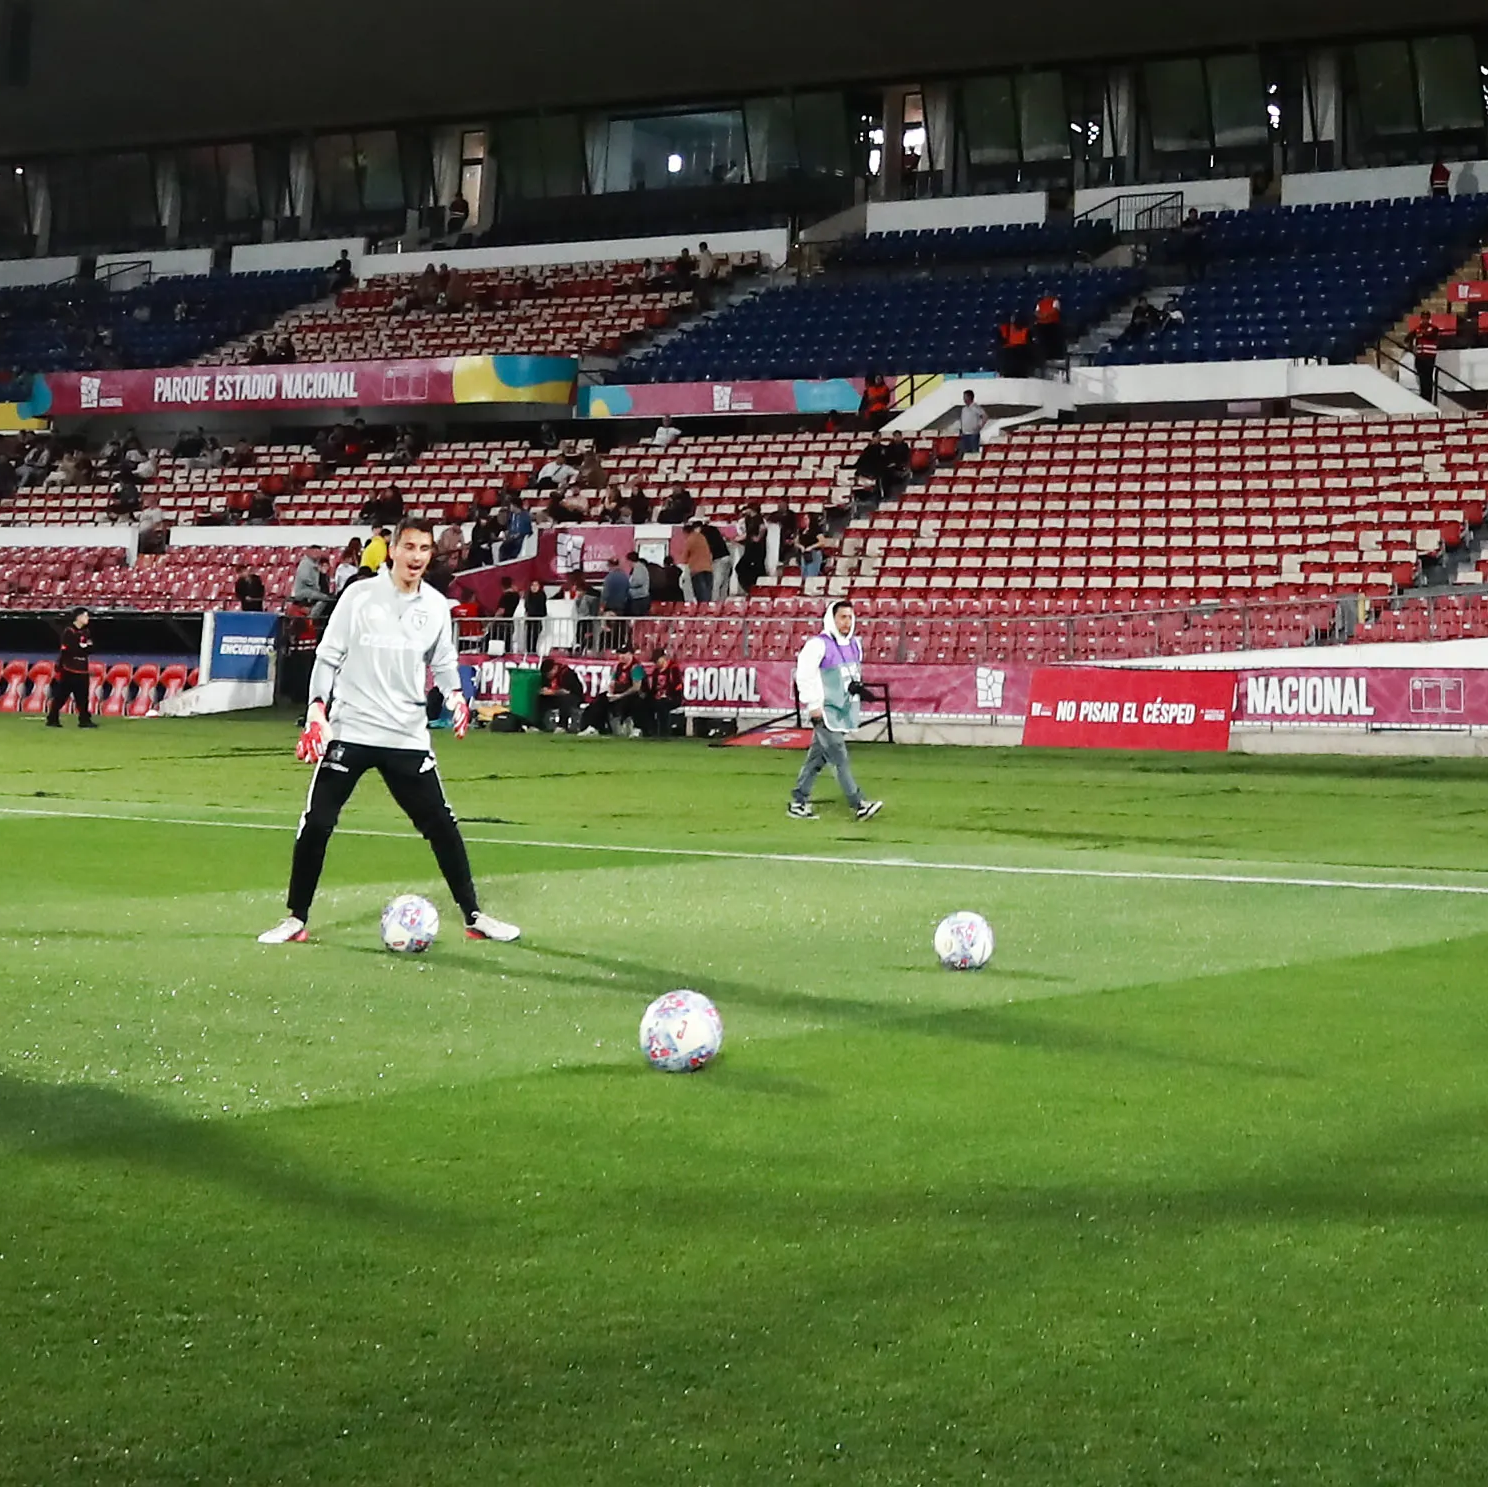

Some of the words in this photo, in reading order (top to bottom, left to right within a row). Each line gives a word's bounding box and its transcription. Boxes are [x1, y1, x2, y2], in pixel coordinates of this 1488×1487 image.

[153, 375, 210, 405] PARQUE
[214, 373, 277, 401] ESTADIO
[281, 371, 359, 400] NACIONAL
[683, 665, 762, 702] CIONAL
[1247, 676, 1375, 716] NACIONAL
[1055, 700, 1077, 722] NO
[1078, 700, 1120, 724] PISAR
[1122, 702, 1139, 724] EL
[1143, 697, 1197, 725] CÉSPED
